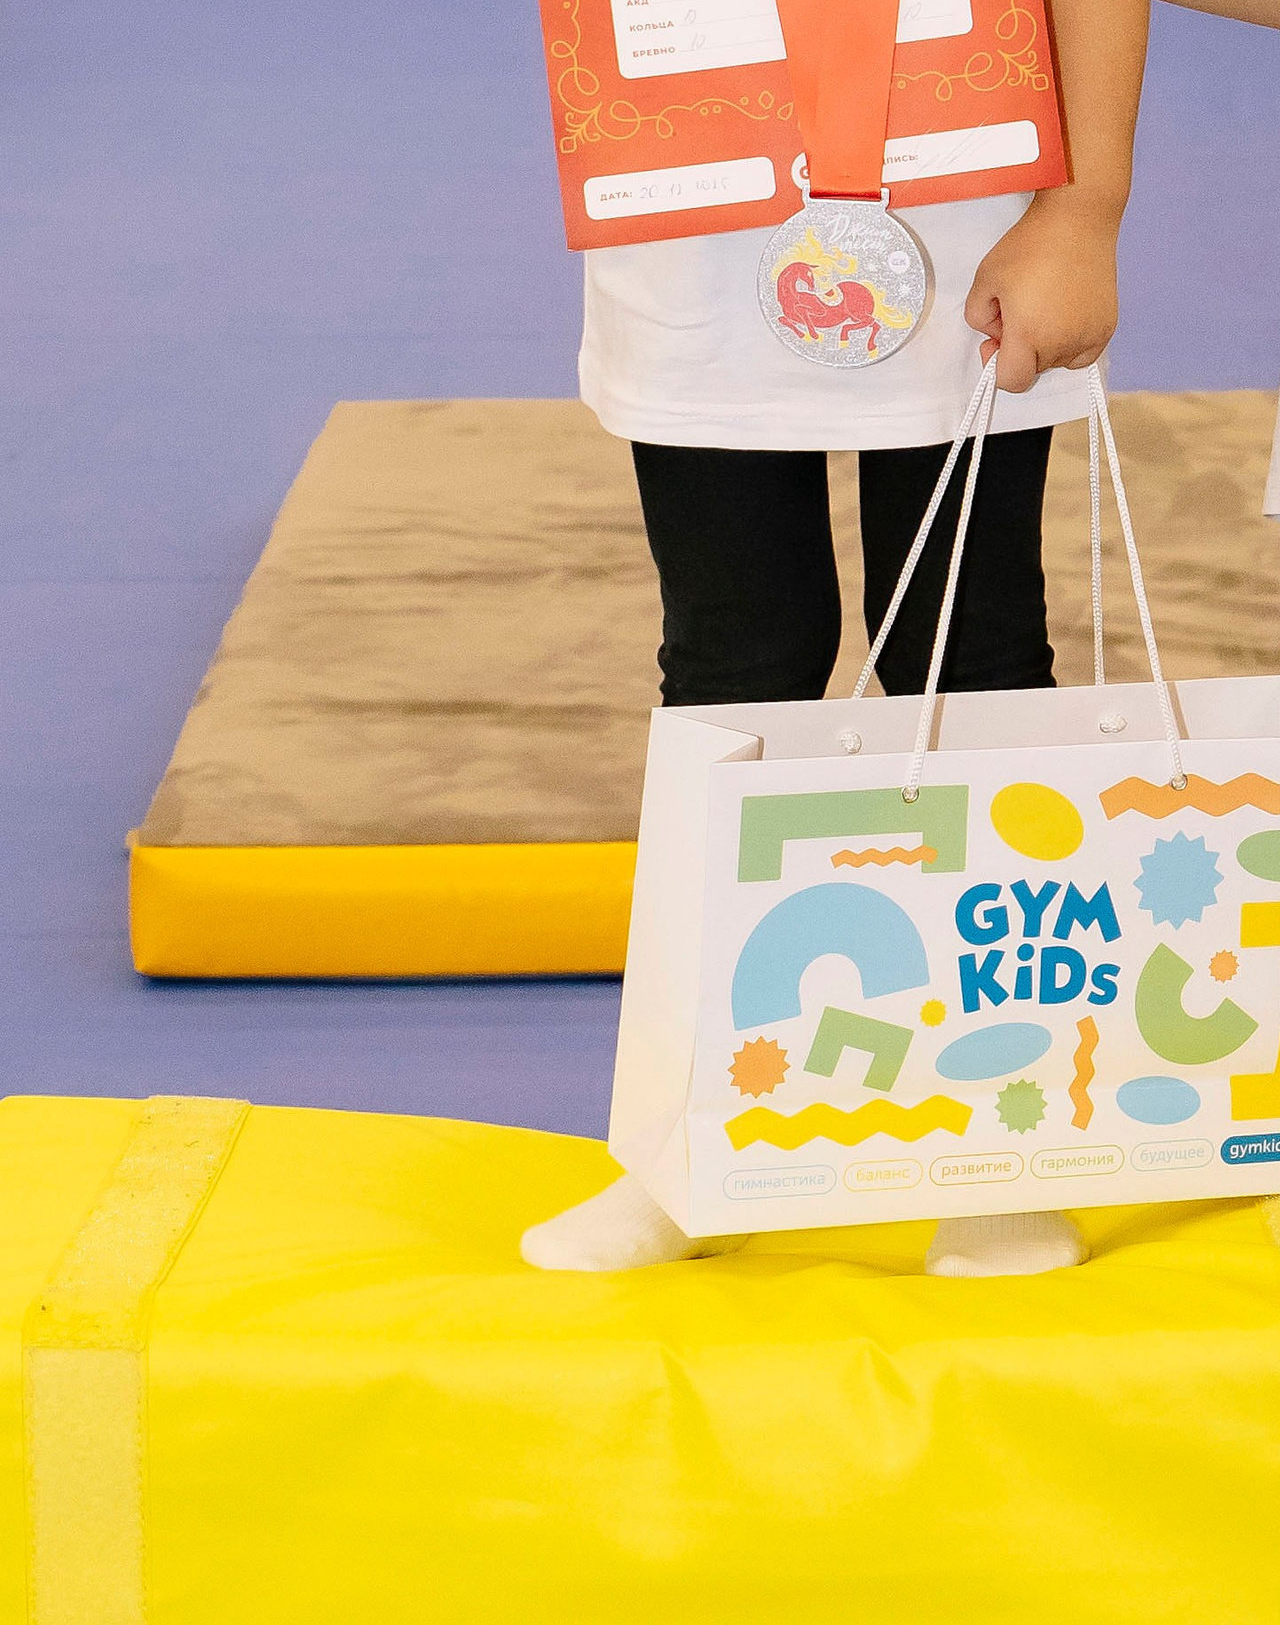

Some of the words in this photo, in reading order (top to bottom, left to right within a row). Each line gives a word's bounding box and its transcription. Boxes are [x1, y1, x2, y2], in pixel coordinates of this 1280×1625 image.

[629, 20, 675, 33] КОЛЬЦА
[632, 46, 676, 58] БРЕВНО
[600, 191, 633, 202] ДАТА:
[955, 879, 1123, 943] GYM
[734, 1174, 826, 1192] гимнастика
[856, 1167, 911, 1182] баланс
[941, 1160, 1013, 1180] развитие
[1040, 1154, 1115, 1172] гармония
[1140, 1146, 1206, 1165] будущее
